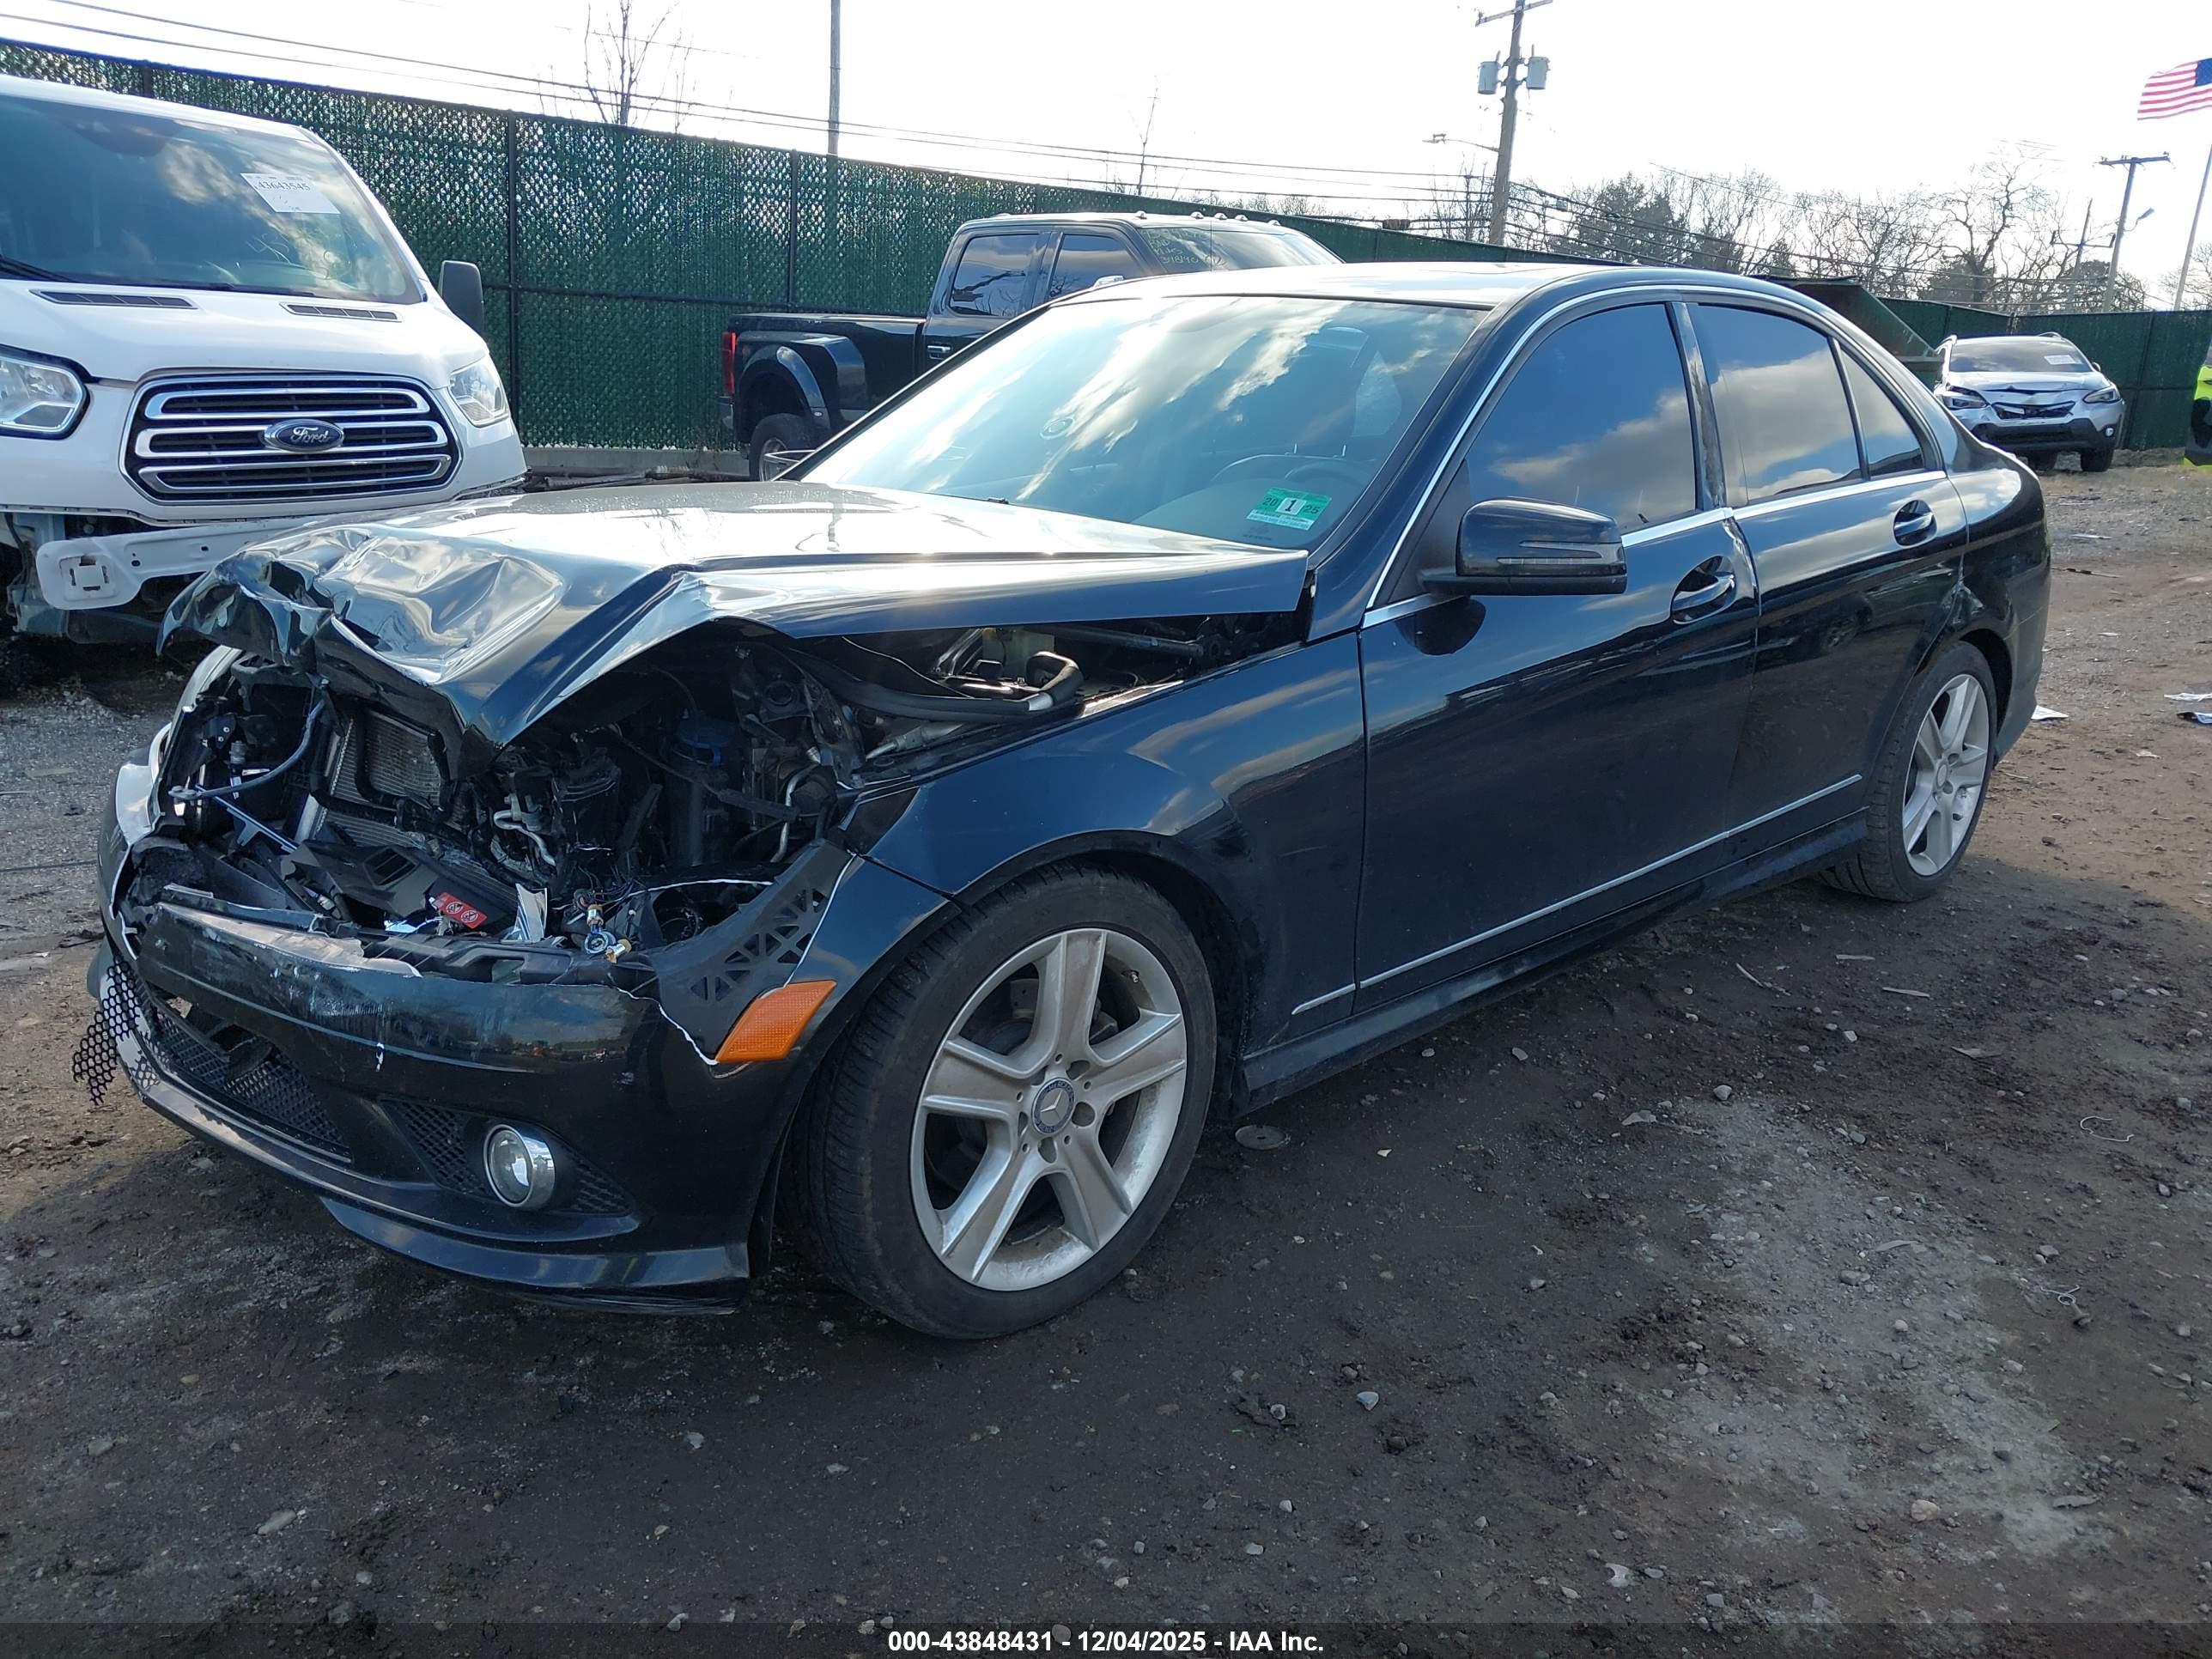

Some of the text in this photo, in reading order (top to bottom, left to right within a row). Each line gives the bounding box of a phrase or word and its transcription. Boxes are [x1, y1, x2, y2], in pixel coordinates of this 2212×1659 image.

[290, 427, 330, 443] Ford
[1262, 497, 1320, 514] 20 1 25
